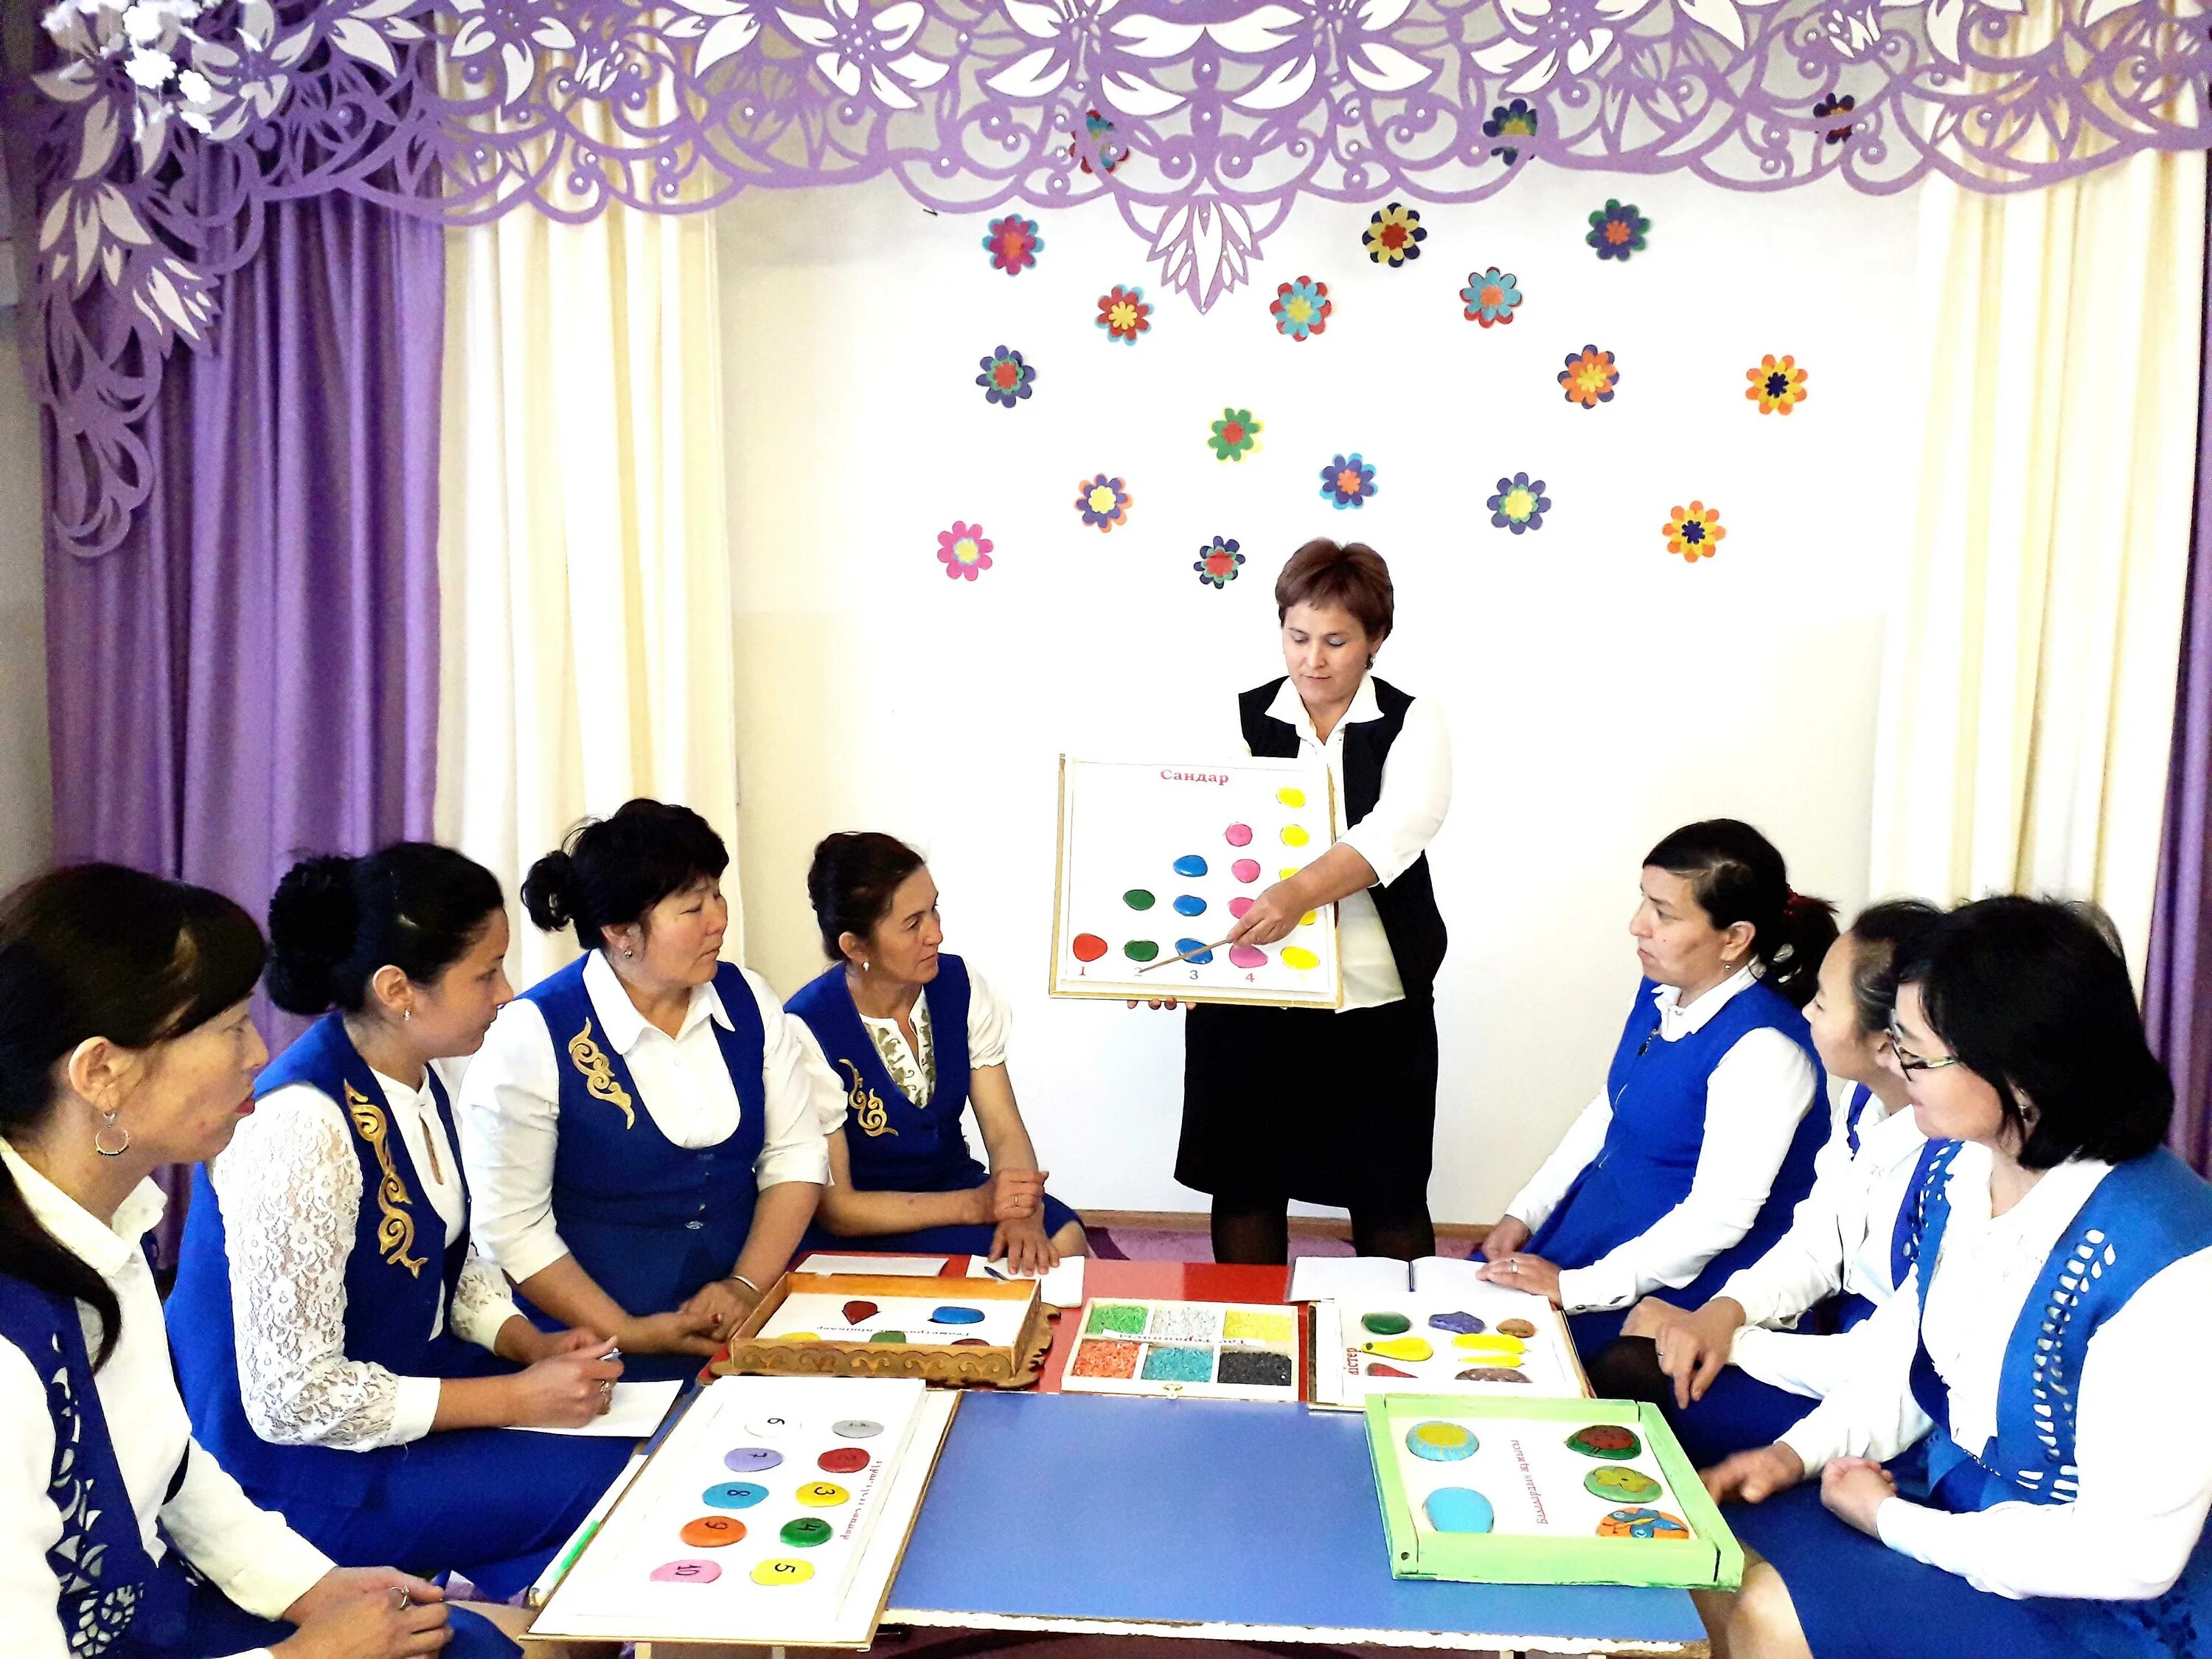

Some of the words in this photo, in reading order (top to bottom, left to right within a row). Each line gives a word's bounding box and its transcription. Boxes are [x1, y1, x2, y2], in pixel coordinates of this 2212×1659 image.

[1160, 769, 1229, 786] Сандар
[1079, 966, 1087, 977] 1
[1133, 967, 1144, 977] 2
[1189, 970, 1199, 980] 3
[1245, 973, 1255, 983] 4
[814, 1486, 835, 1495] 3
[705, 1520, 728, 1530] 9
[798, 1523, 821, 1532] 4
[675, 1563, 702, 1576] 10
[774, 1562, 796, 1573] 5
